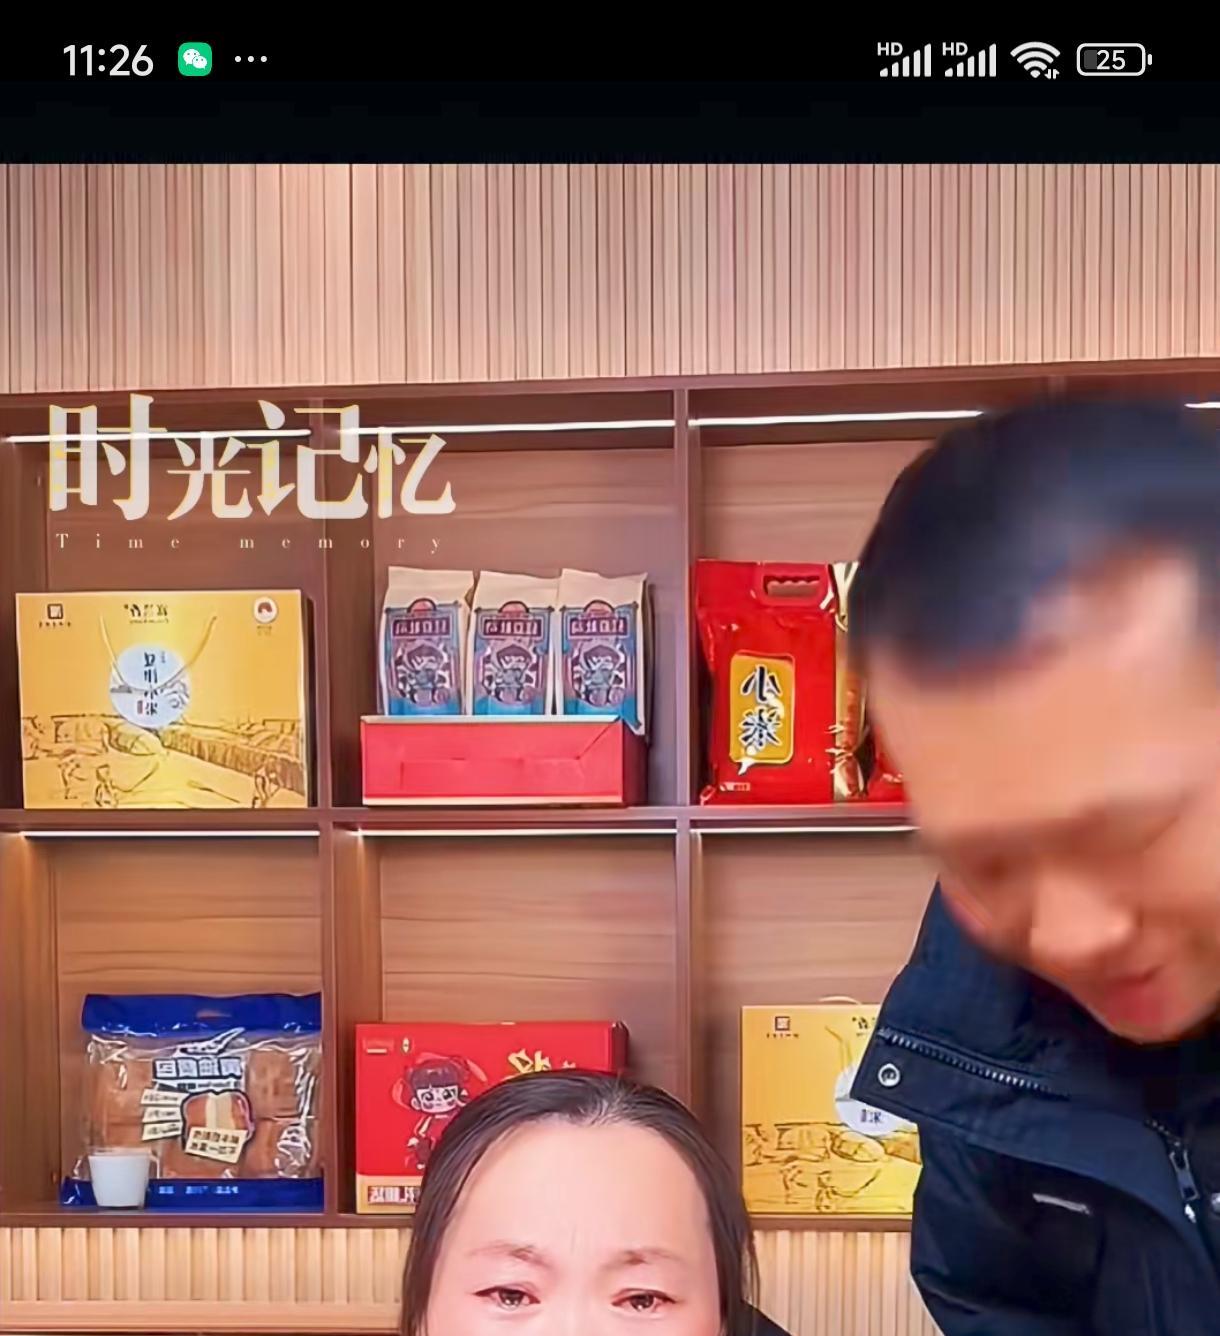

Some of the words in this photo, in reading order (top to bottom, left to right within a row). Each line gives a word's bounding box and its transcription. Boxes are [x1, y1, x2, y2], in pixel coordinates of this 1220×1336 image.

[877, 42, 904, 56] HD
[942, 42, 969, 56] HD
[64, 44, 153, 77] 11:26
[1097, 50, 1126, 70] 25
